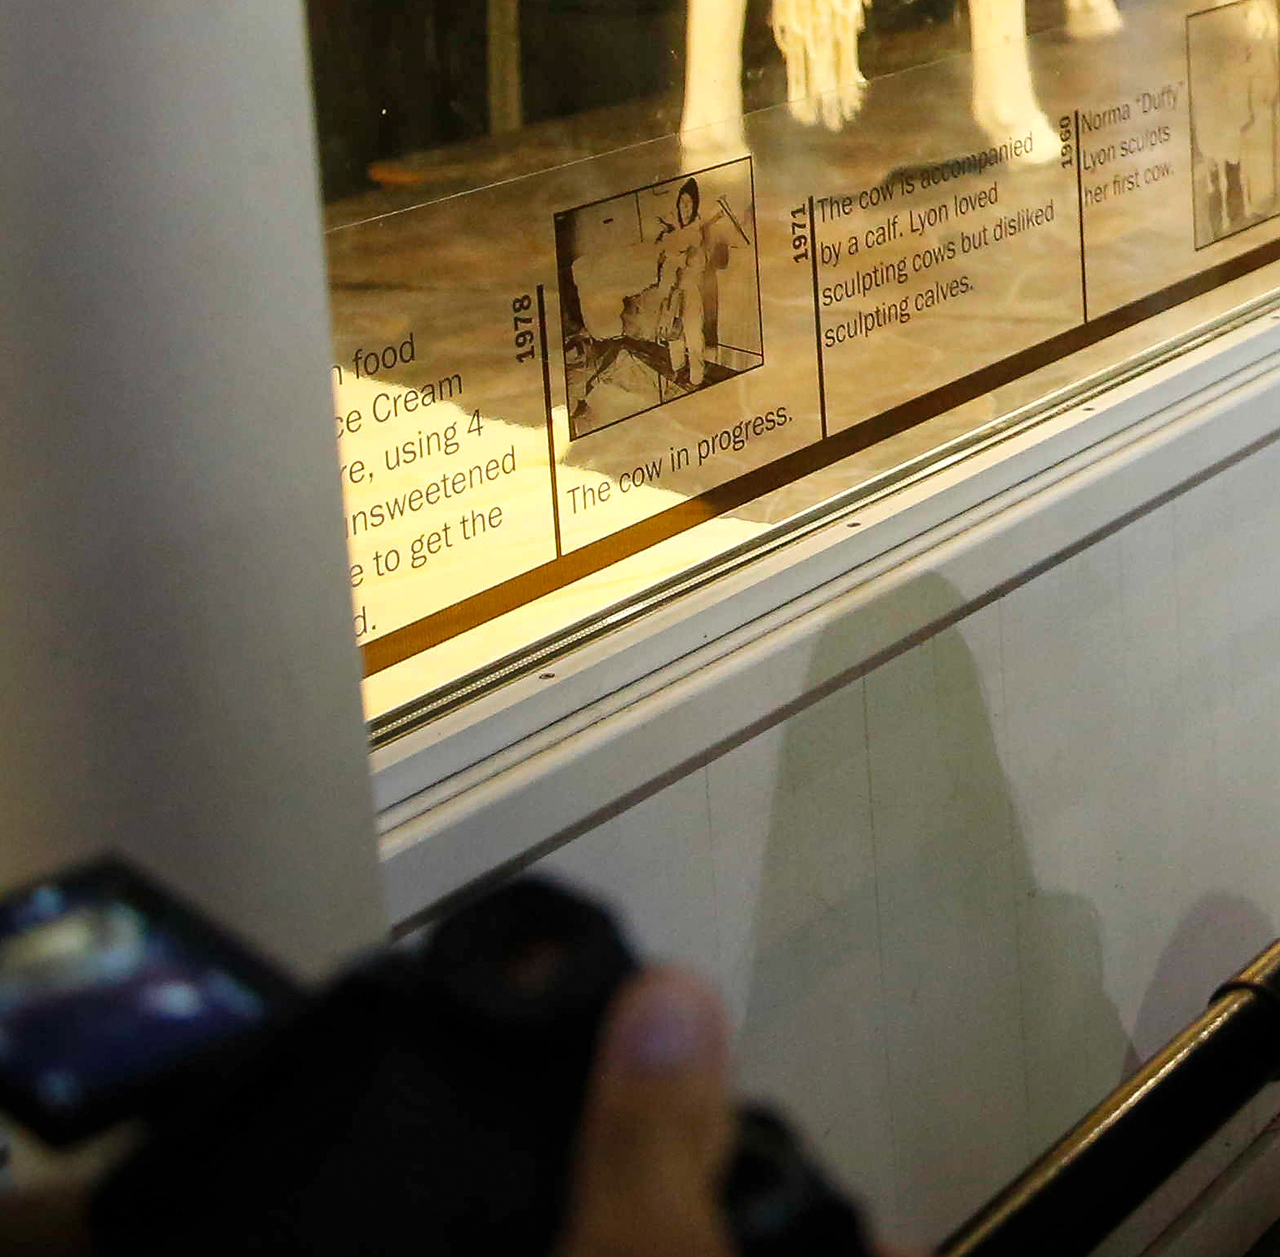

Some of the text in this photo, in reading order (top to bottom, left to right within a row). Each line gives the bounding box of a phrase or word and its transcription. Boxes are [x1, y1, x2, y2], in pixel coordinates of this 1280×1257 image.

[1059, 115, 1073, 169] 1960
[1081, 103, 1130, 134] Norma
[1083, 125, 1171, 174] Lyon sculpts
[817, 131, 1035, 224] The cow is accompanied
[1084, 183, 1109, 206] her
[1113, 169, 1140, 195] first
[790, 202, 808, 264] 1971
[820, 182, 1000, 268] by a calf. Lyon loved
[821, 199, 1056, 308] sculpting cows but disliked
[514, 294, 535, 363] 1978
[824, 273, 974, 349] sculpting calves.
[353, 332, 416, 379] food
[372, 372, 463, 423] Cream
[384, 421, 460, 471] using
[467, 409, 484, 438] 4
[566, 405, 795, 516] The cow in progress.
[345, 445, 517, 538] nsweetened
[373, 549, 400, 577] to
[410, 523, 454, 568] get
[460, 505, 503, 542] the
